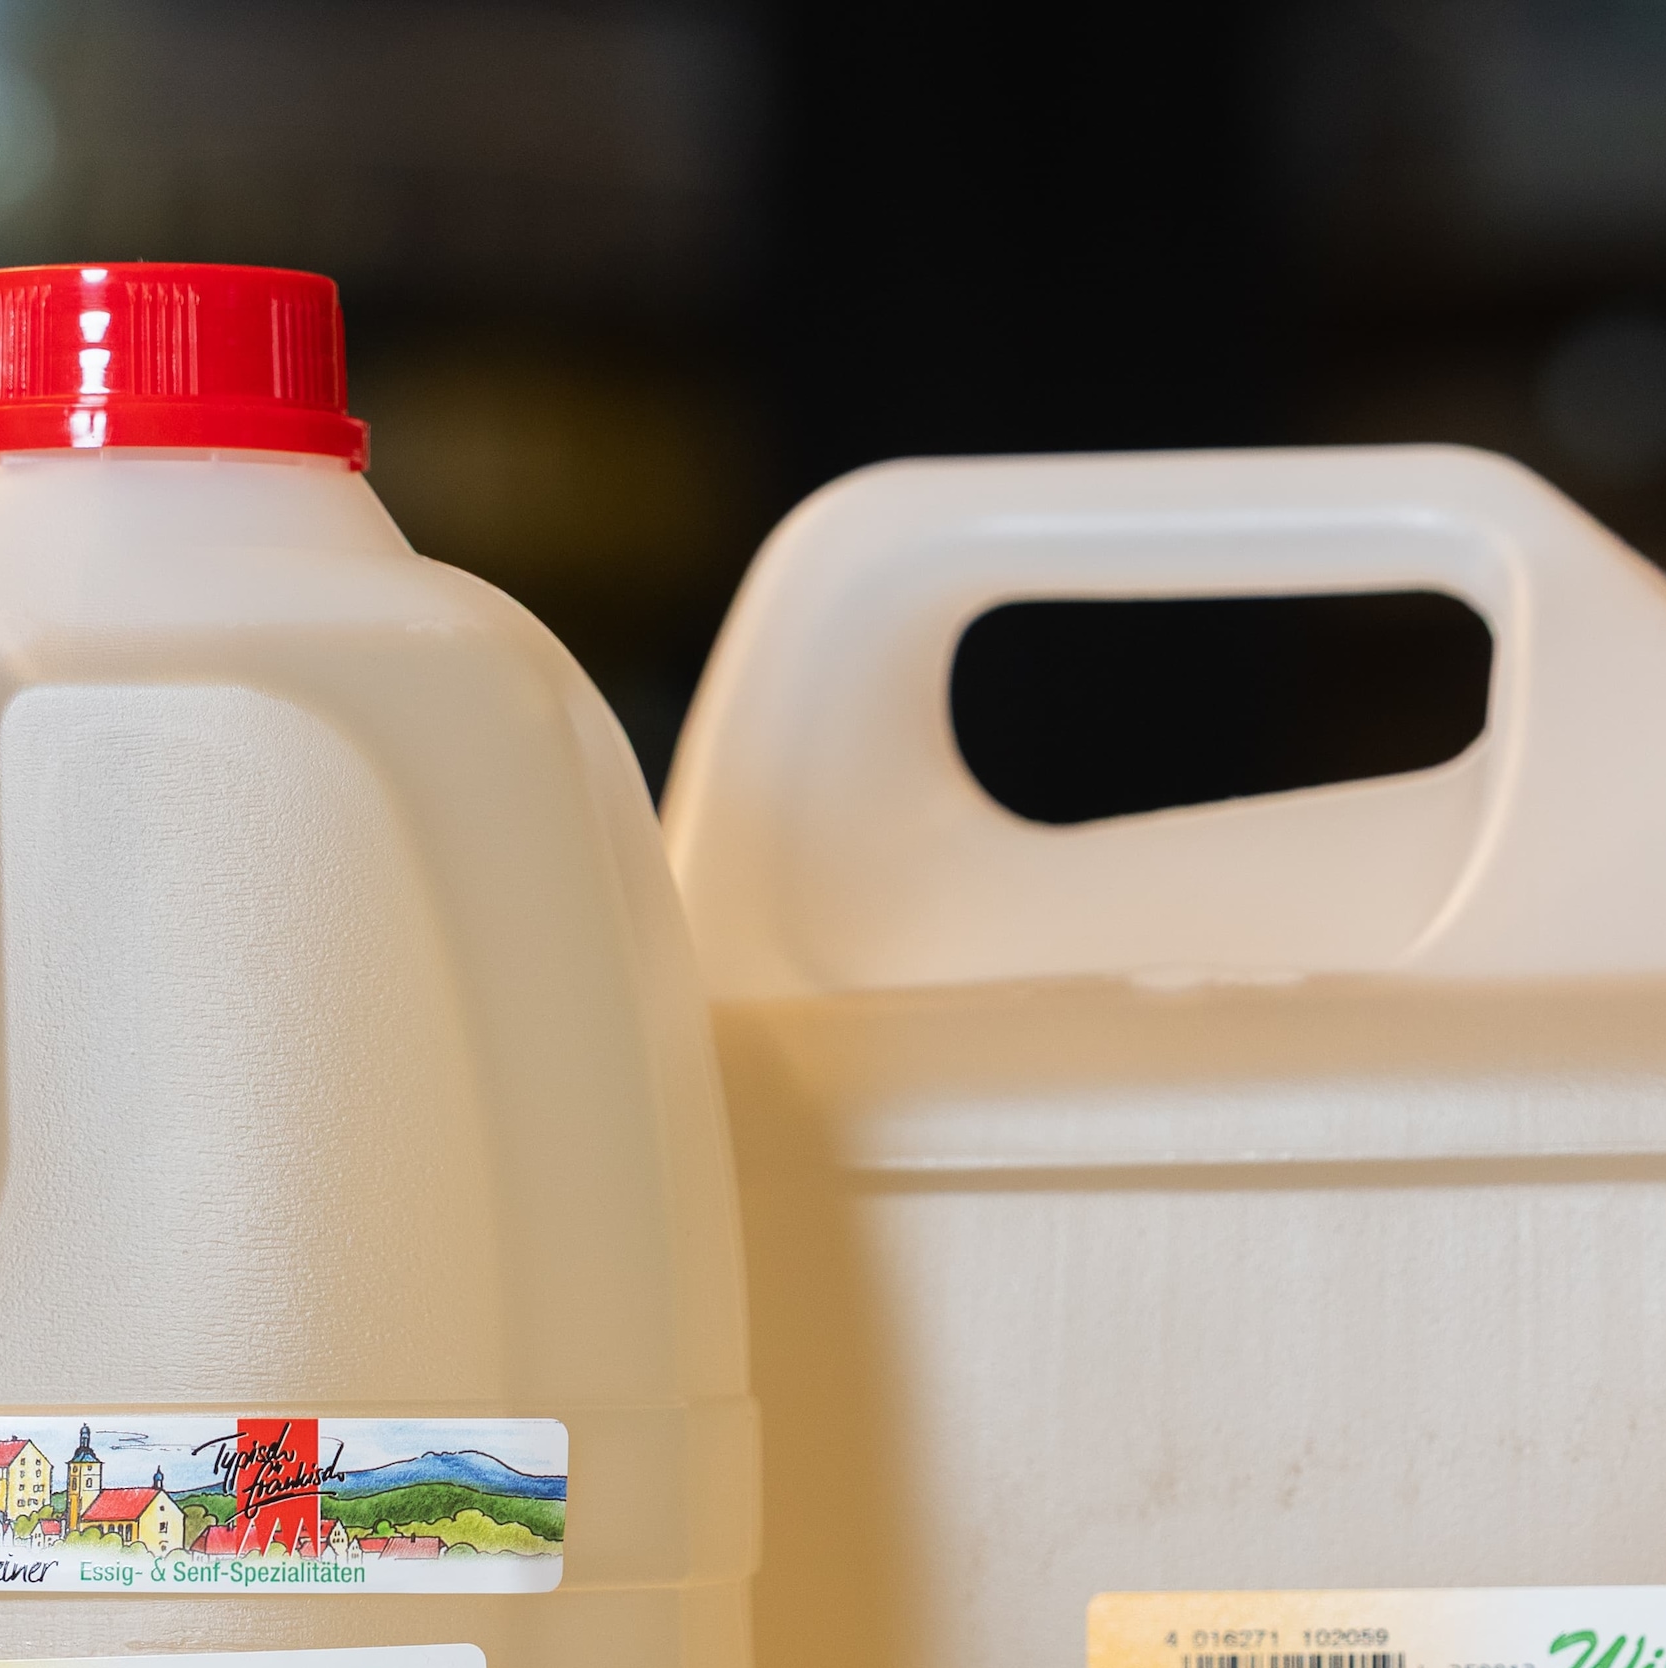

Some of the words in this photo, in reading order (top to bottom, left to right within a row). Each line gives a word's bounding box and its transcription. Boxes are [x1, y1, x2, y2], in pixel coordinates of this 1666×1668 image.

[80, 1561, 143, 1587] Essig-
[150, 1559, 166, 1583] &
[173, 1561, 365, 1586] Senf-Spezialitäten
[1165, 1630, 1178, 1647] 4
